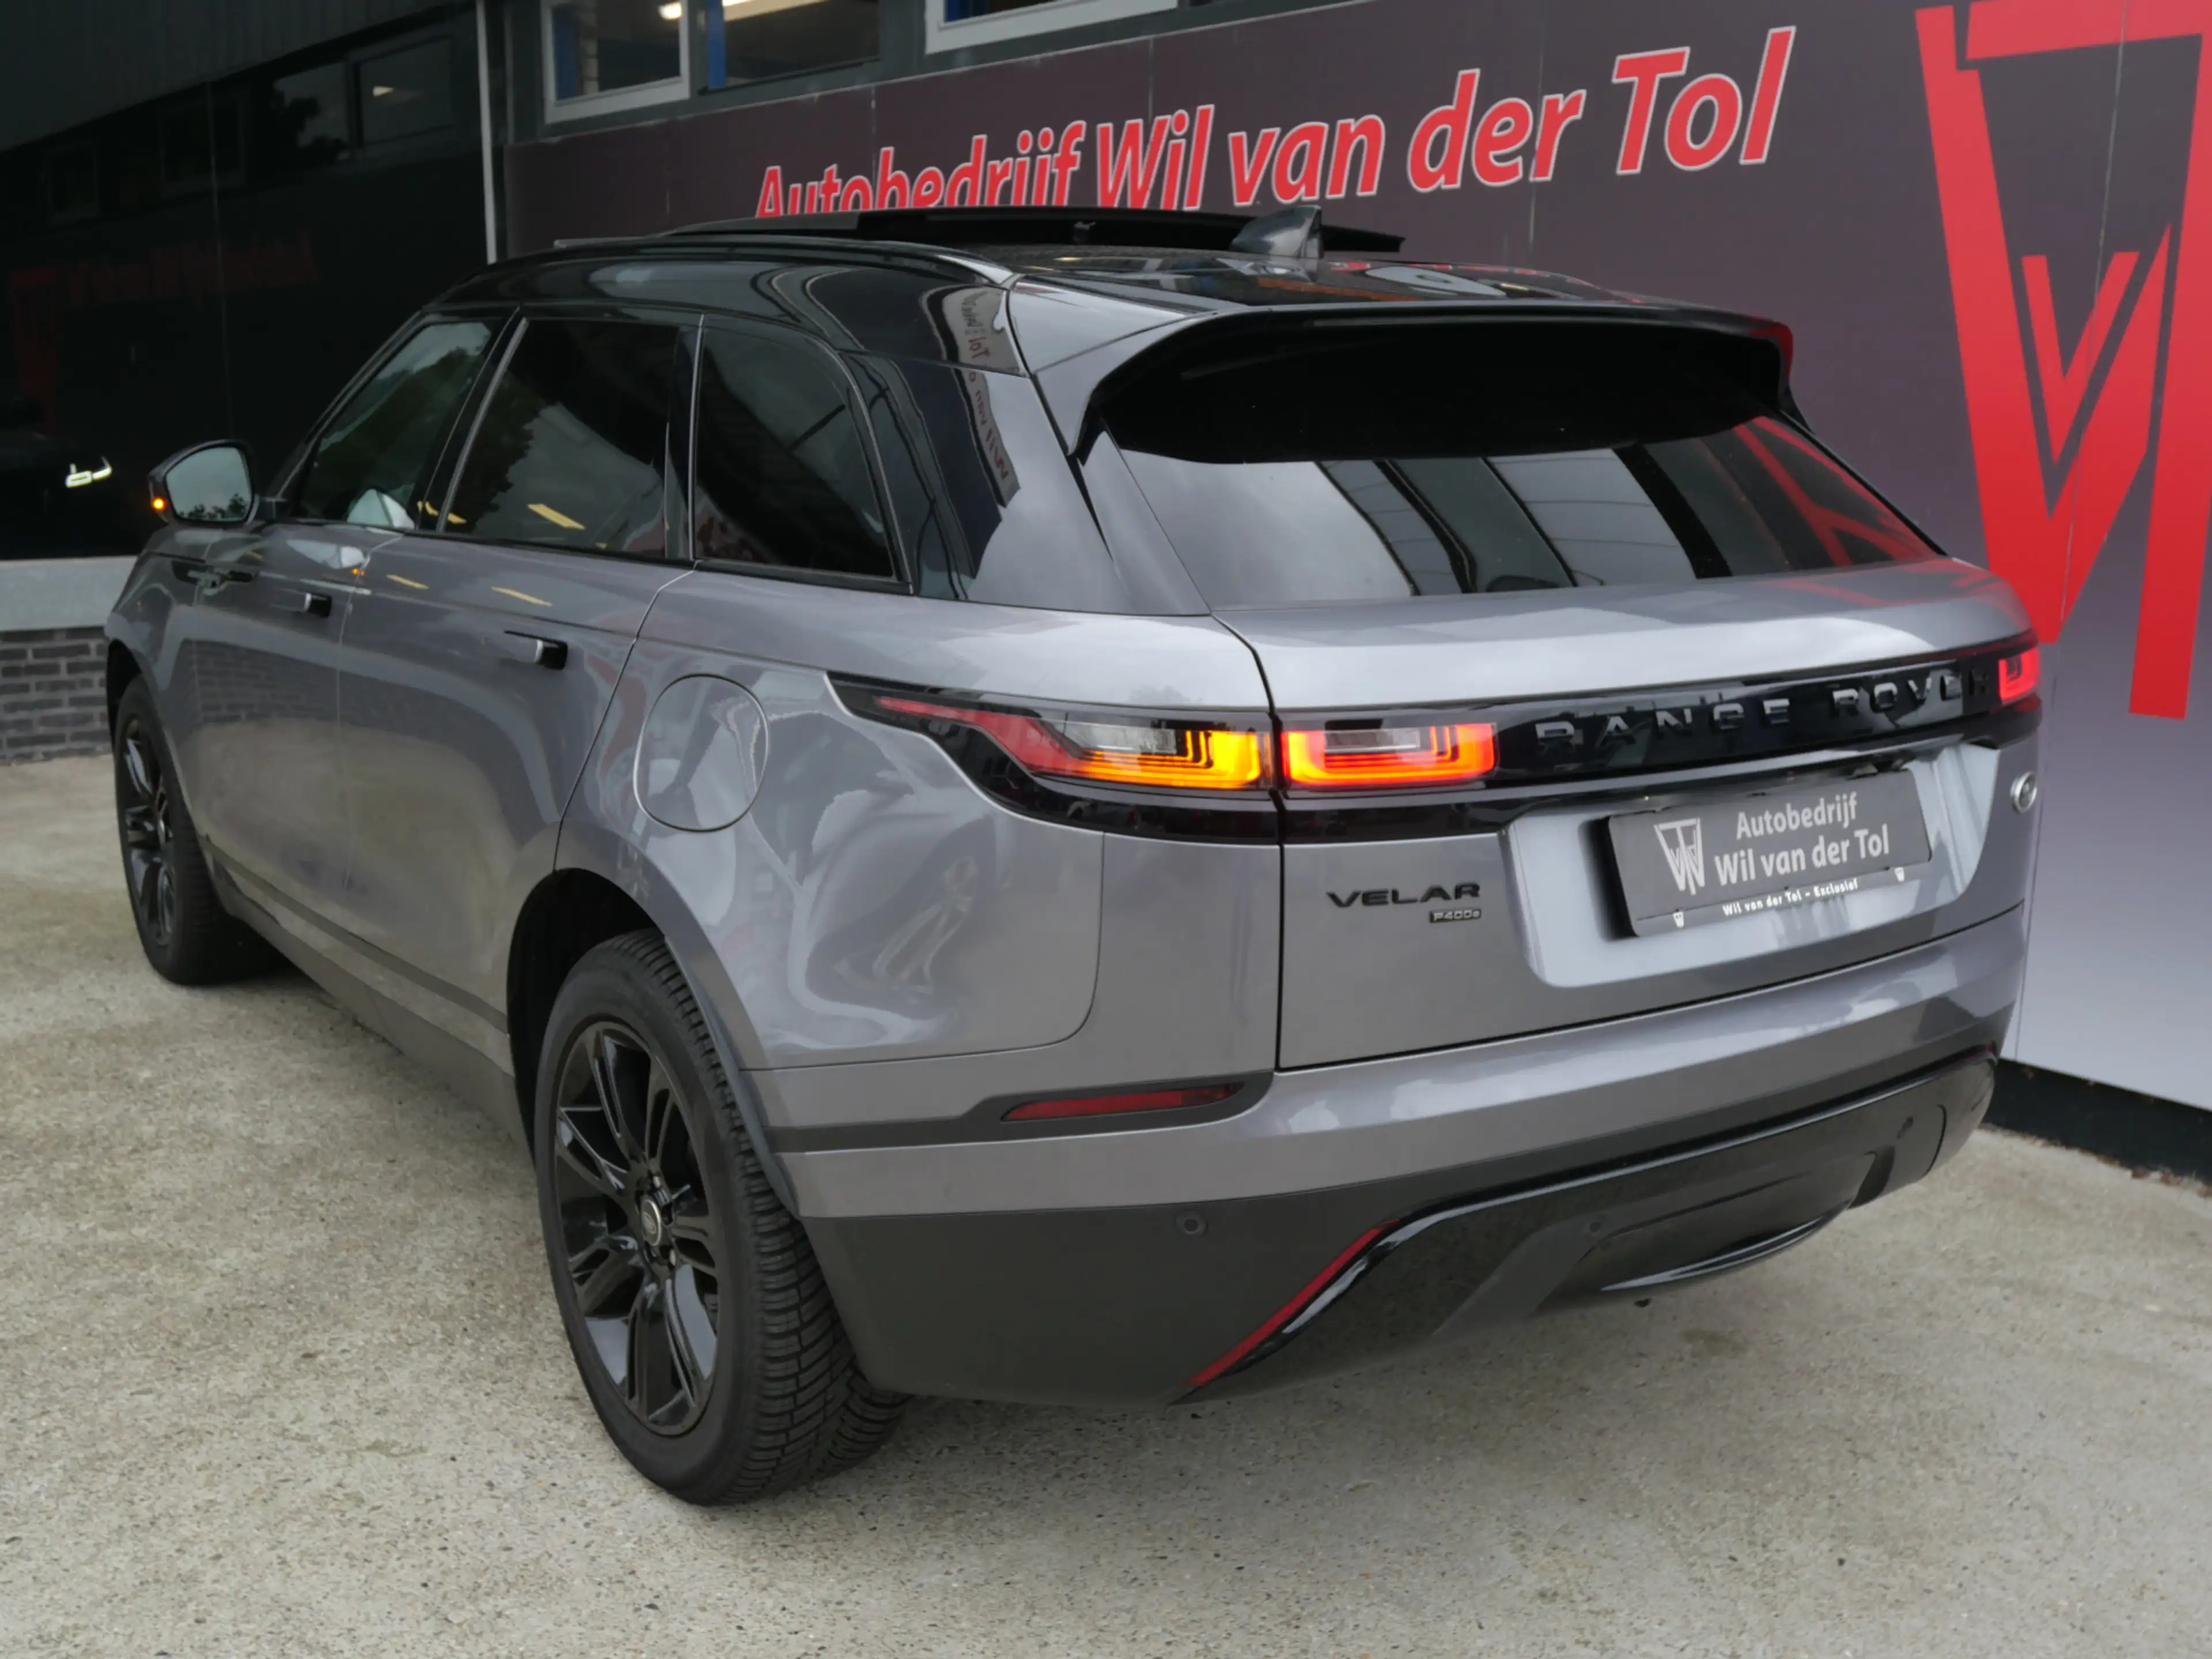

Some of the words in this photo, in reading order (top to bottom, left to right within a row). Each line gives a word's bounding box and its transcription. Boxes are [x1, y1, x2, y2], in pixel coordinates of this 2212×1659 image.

[1096, 104, 1215, 210] Wil
[1228, 113, 1385, 207] van
[1407, 68, 1586, 192] der
[1612, 25, 1796, 175] Tol
[1535, 697, 1791, 753] RANGE
[1736, 790, 1857, 840] Autobedrijf
[1714, 847, 1756, 886] Wil
[1760, 847, 1806, 877] van
[1811, 835, 1850, 868] der
[1854, 823, 1889, 859] Tol
[1325, 881, 1480, 909] VELAR
[1433, 908, 1480, 922] P400e
[1722, 901, 1742, 916] Wil
[1744, 899, 1763, 912] van
[1766, 895, 1782, 908] der
[1785, 889, 1802, 903] Tol
